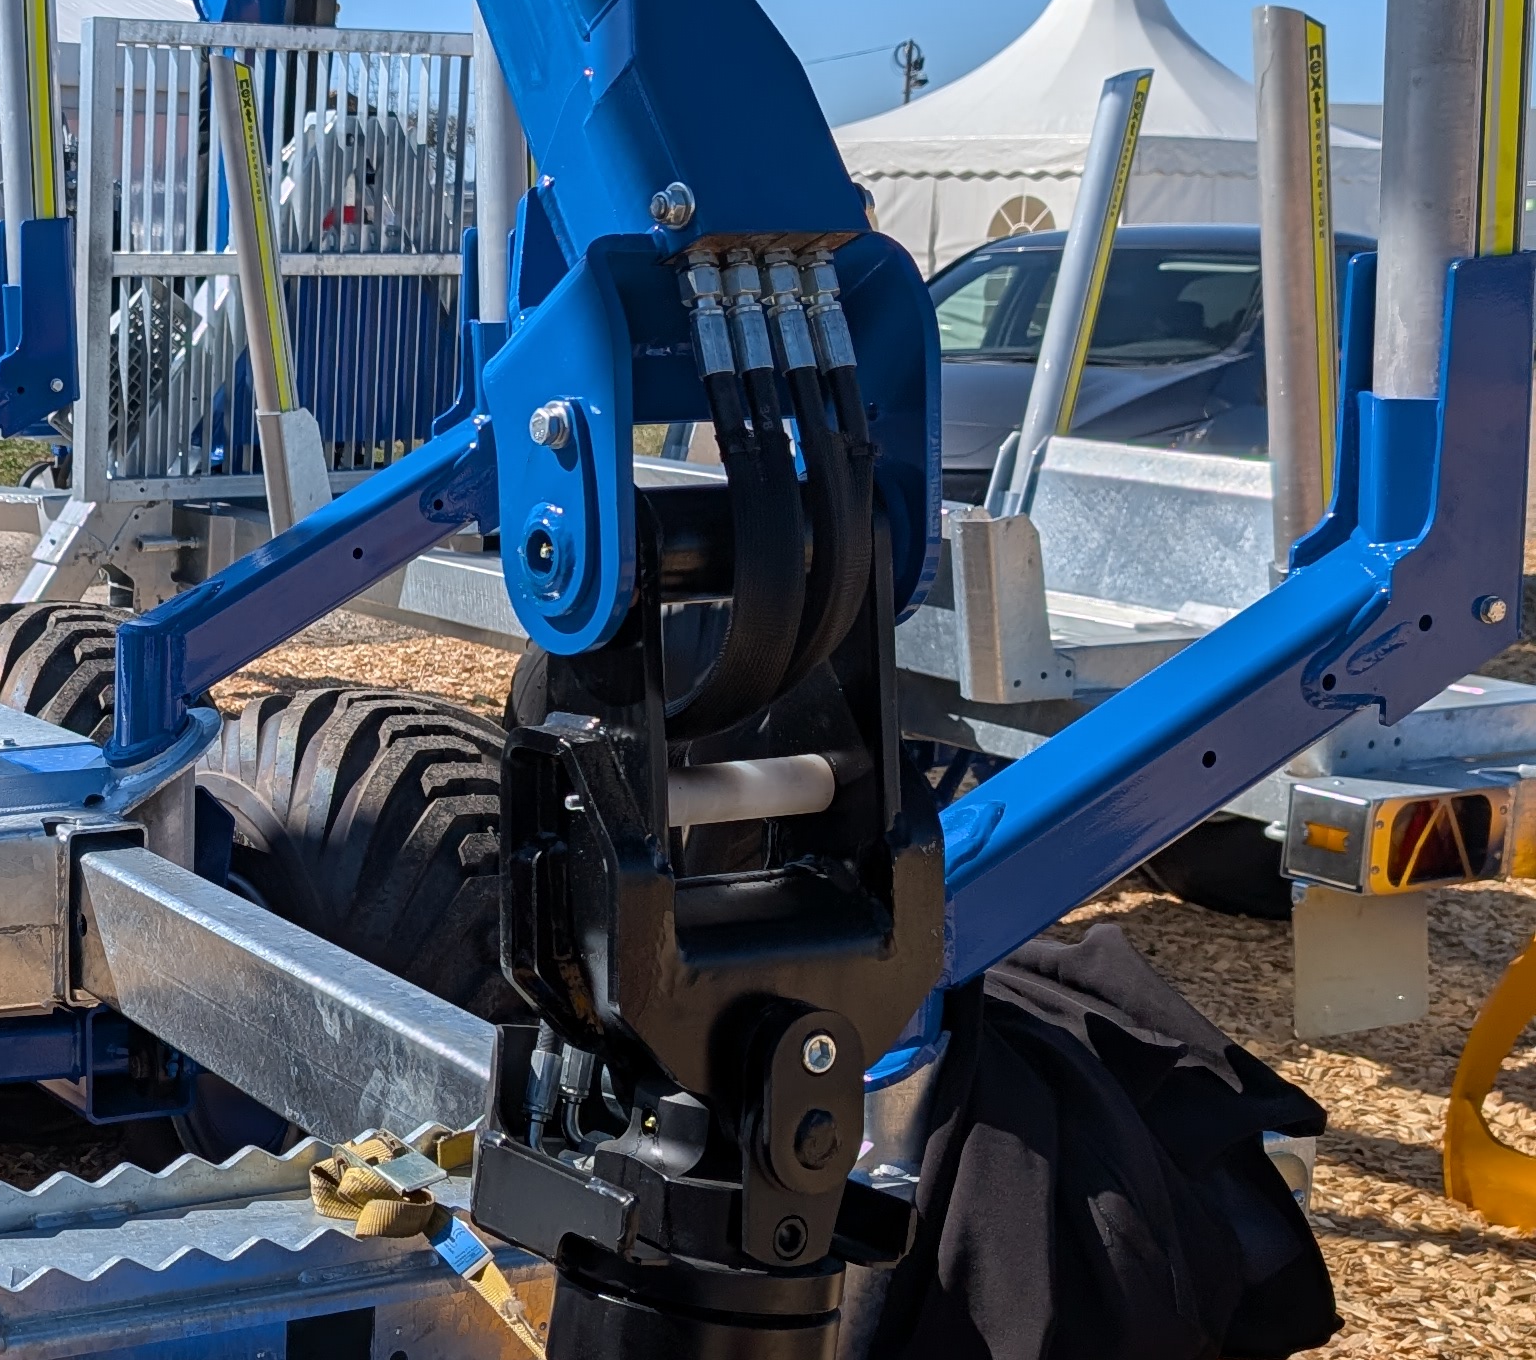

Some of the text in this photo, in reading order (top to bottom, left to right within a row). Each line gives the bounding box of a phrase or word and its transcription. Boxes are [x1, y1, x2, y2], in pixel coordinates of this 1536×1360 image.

[239, 79, 253, 123] next
[1130, 91, 1145, 136] next
[1308, 44, 1325, 239] next generation
